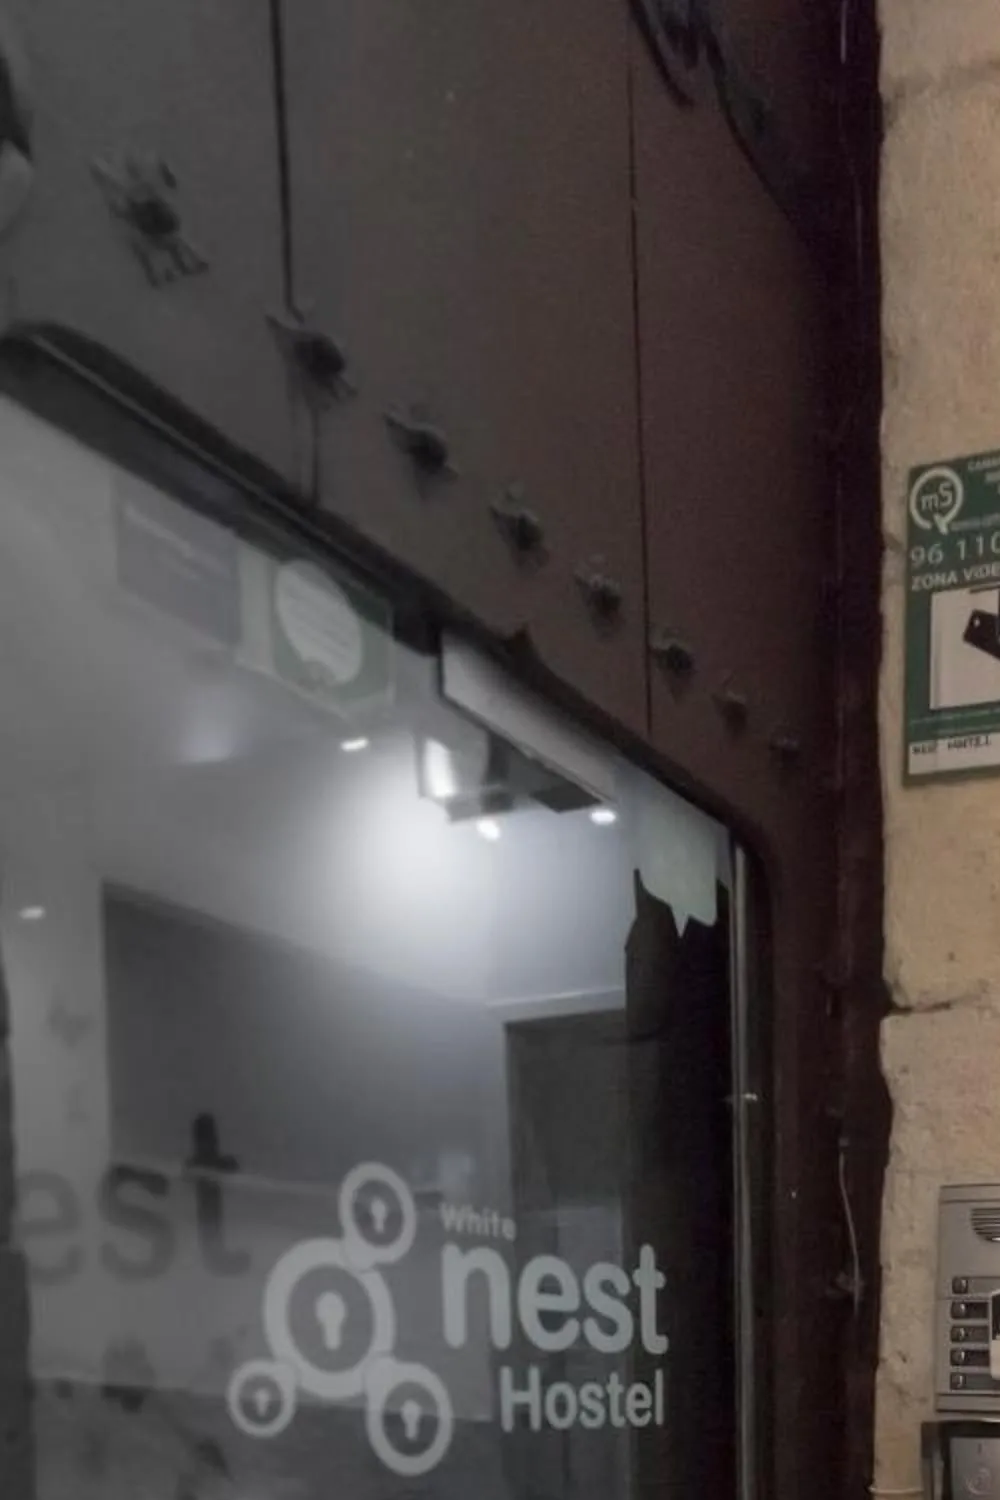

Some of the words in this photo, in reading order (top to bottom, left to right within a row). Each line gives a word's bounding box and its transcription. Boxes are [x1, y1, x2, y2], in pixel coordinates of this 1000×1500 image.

[910, 543, 944, 568] 96
[911, 571, 958, 591] ZONA
[439, 1202, 516, 1240] White
[441, 1242, 669, 1356] nest
[499, 1365, 664, 1433] Hostel
